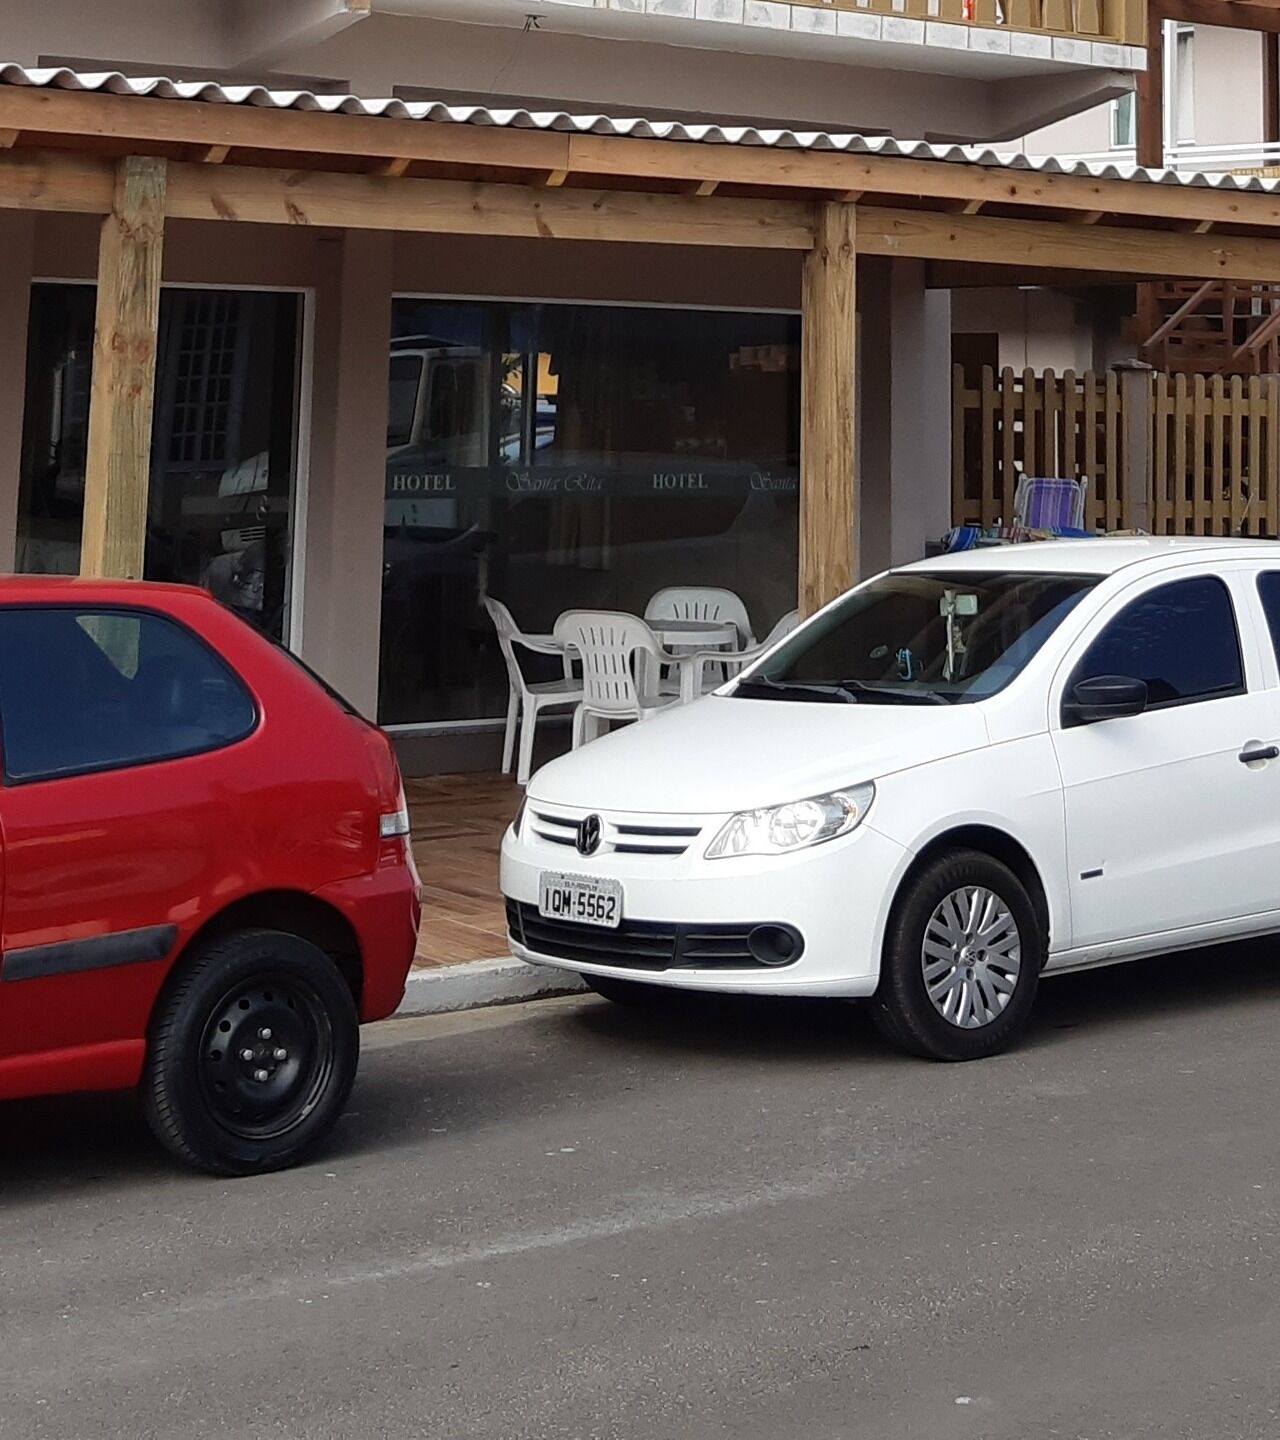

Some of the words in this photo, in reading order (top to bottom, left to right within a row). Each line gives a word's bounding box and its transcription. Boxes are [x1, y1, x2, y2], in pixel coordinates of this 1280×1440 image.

[392, 474, 457, 492] HOTEL
[505, 471, 562, 493] Santa
[564, 472, 602, 492] Rita
[652, 472, 709, 490] HOTEL
